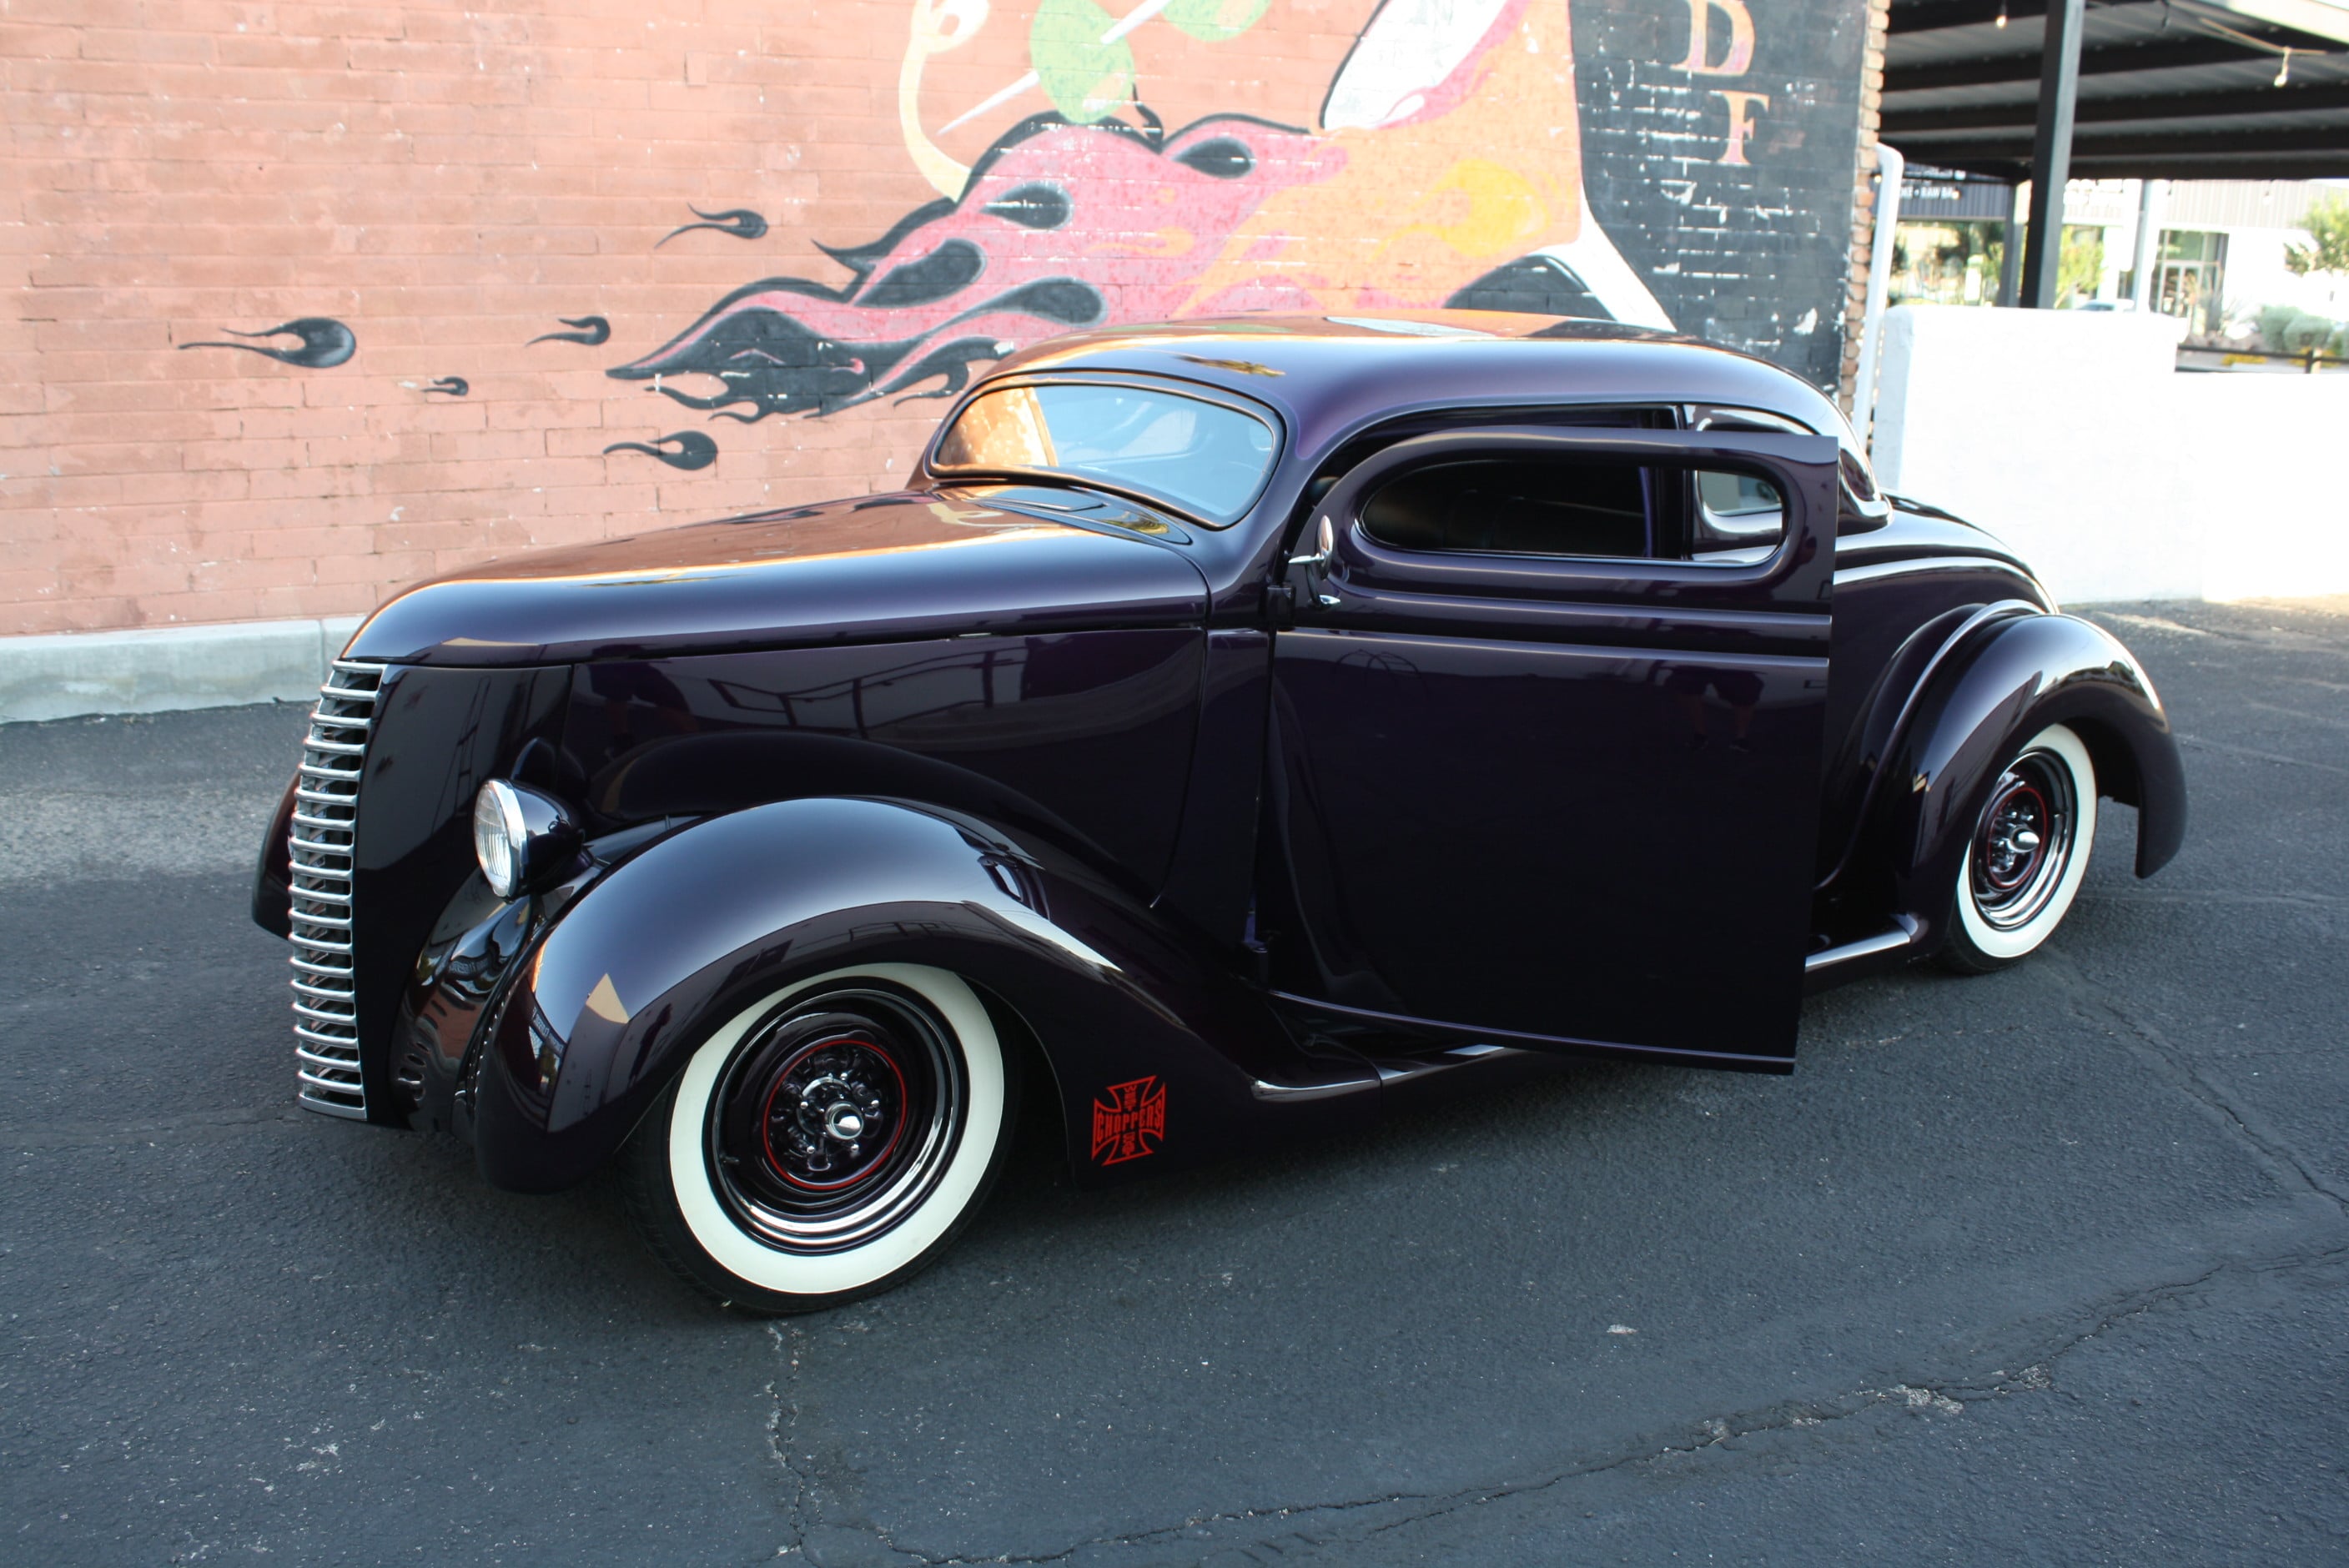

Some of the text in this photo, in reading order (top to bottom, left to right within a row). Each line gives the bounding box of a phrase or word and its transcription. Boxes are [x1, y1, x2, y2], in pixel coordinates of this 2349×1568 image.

[1670, 0, 1755, 76] D
[1709, 89, 1769, 164] F
[1096, 1098, 1162, 1143] CHOPPERS
